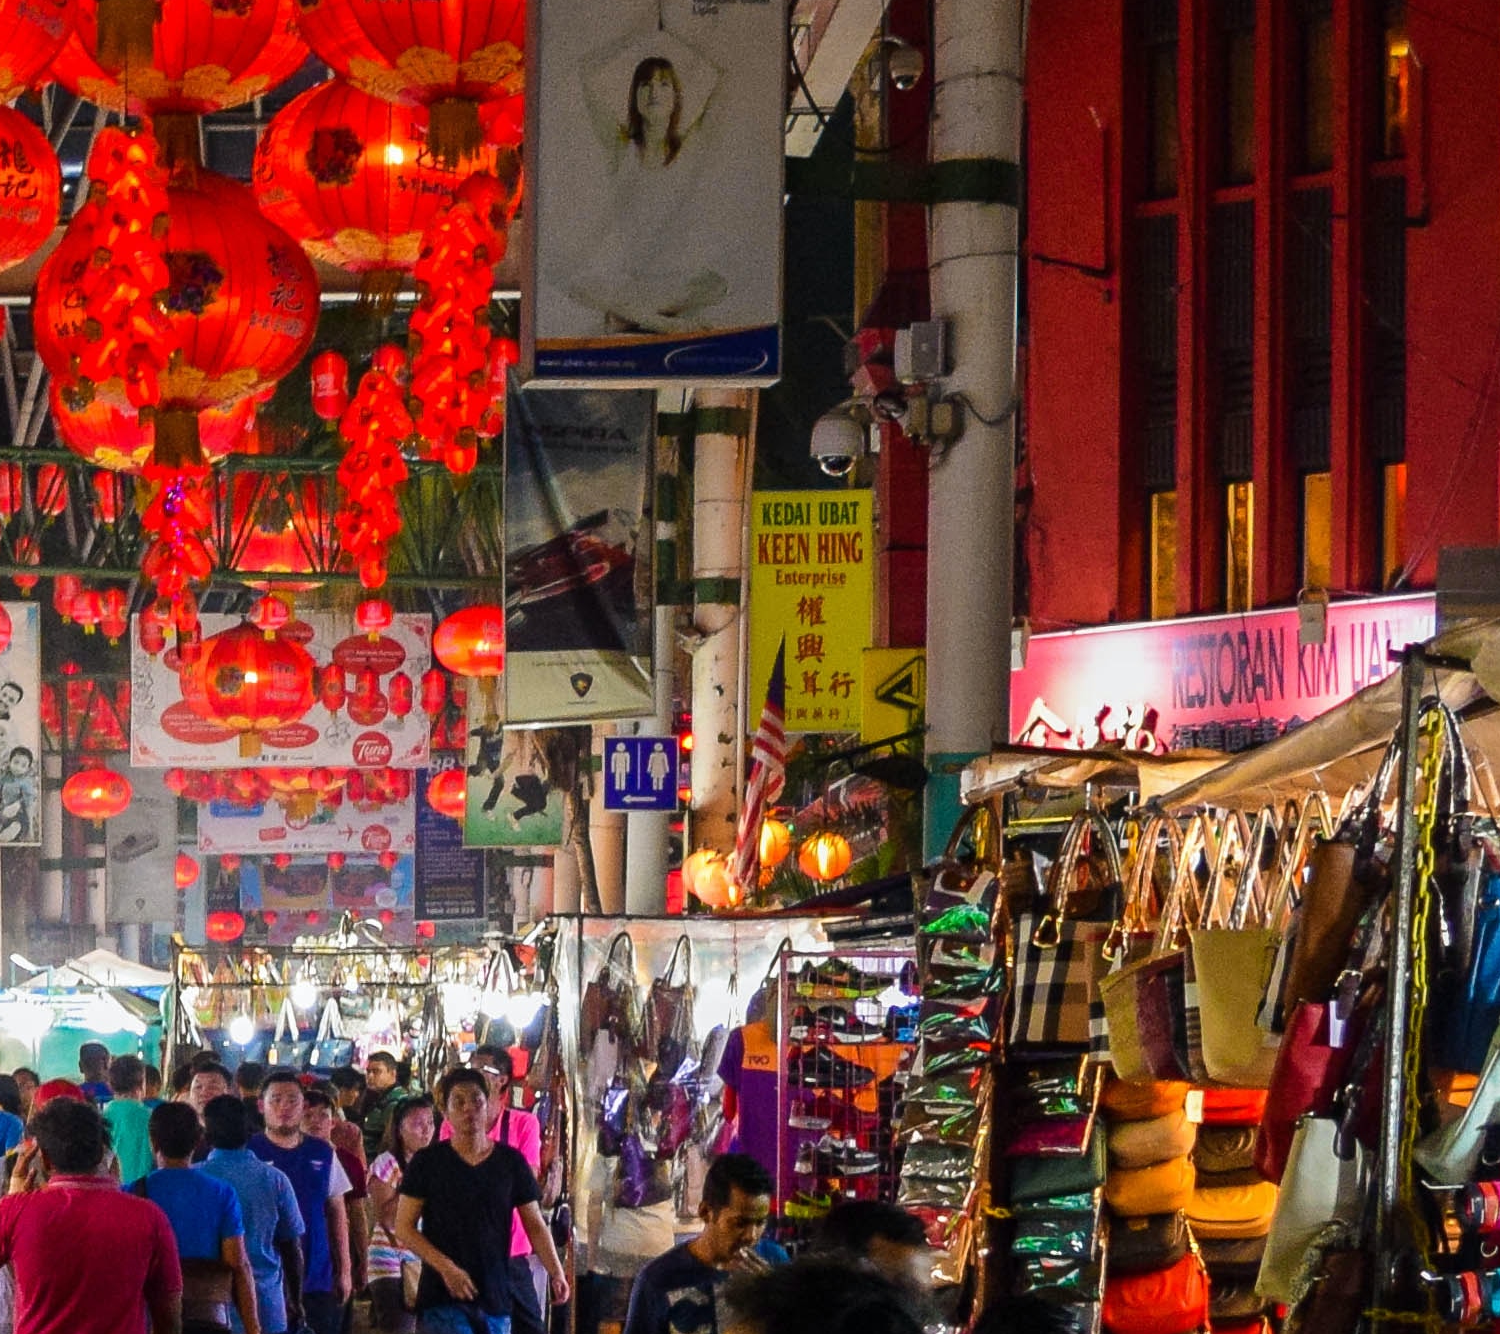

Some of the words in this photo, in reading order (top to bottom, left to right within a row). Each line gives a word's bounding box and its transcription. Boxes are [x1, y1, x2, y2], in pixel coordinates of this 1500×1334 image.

[762, 501, 811, 526] KEDAI
[818, 500, 859, 525] UBAT
[757, 532, 810, 565] KEEN
[817, 531, 864, 564] HING
[775, 569, 847, 589] Enterprise
[1171, 627, 1285, 710] RESTORAN
[1297, 625, 1339, 699] KIM
[359, 741, 390, 759] Tune
